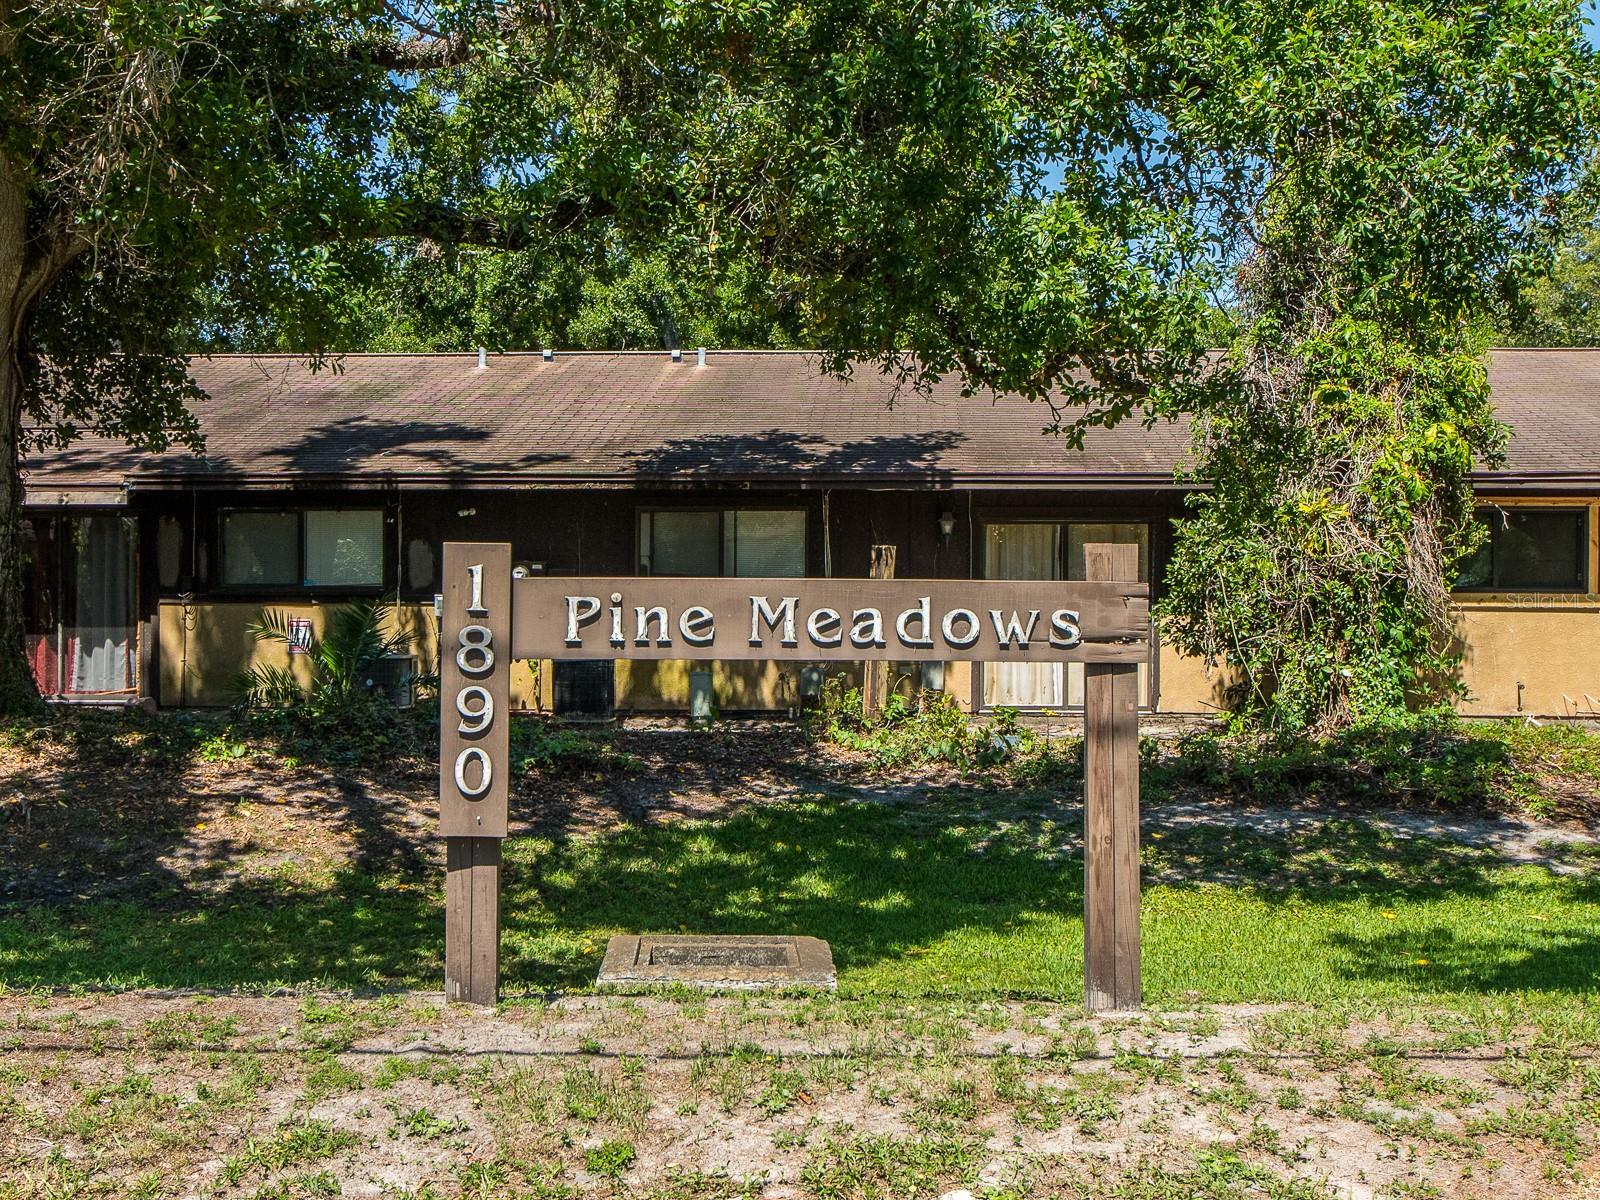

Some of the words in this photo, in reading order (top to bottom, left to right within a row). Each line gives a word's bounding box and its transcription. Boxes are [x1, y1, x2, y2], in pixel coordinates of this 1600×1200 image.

[454, 563, 495, 796] 1890
[564, 591, 716, 645] Pine
[749, 595, 1082, 648] Meadows
